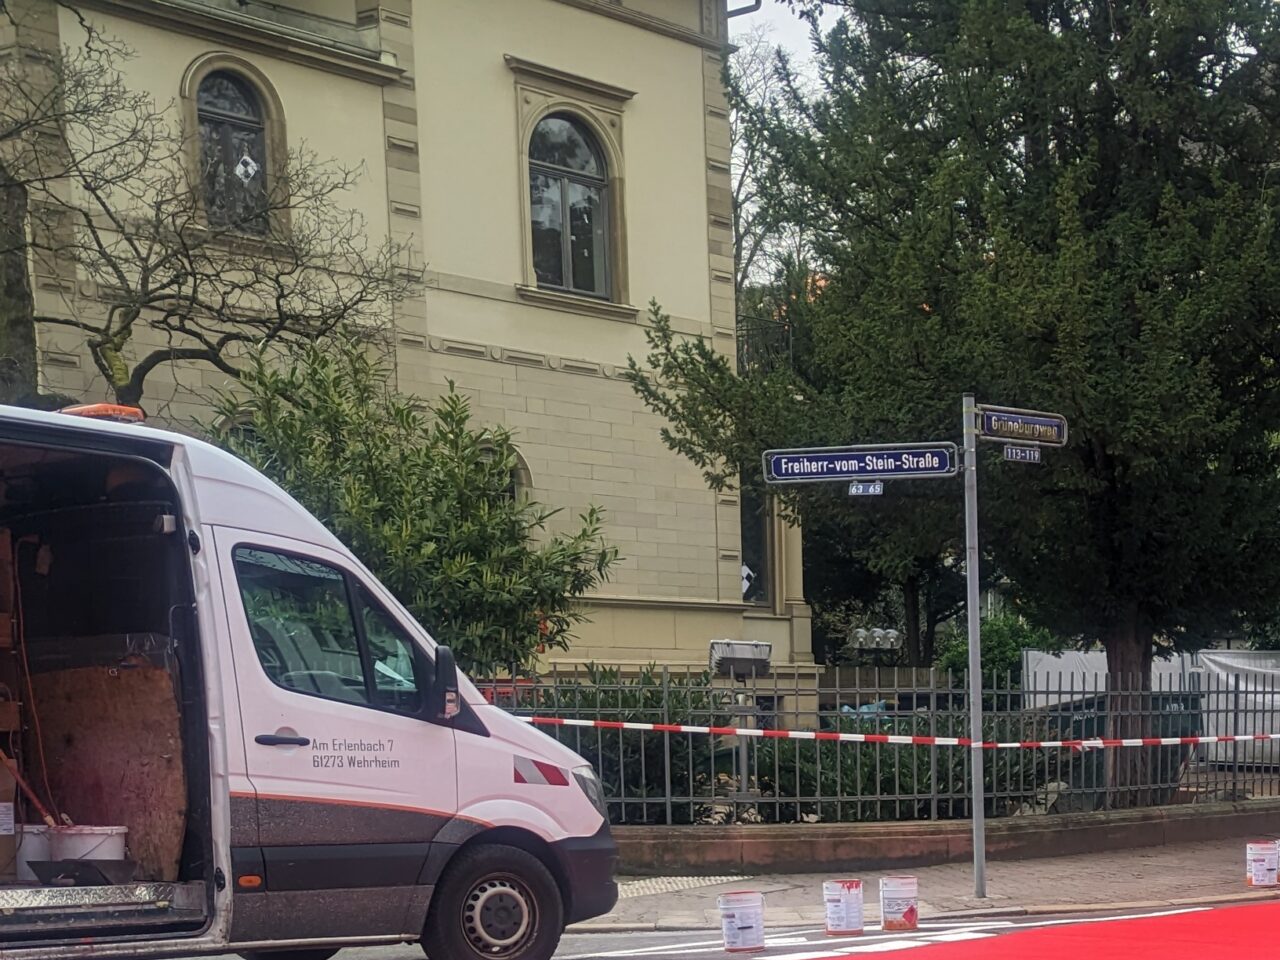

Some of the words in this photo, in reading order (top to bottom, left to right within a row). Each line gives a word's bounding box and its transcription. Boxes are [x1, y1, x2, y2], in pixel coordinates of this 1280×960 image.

[991, 416, 1058, 440] Grüneburgweg
[1007, 448, 1039, 461] 113-119
[781, 452, 939, 473] Freiherr-vom-Stein-Straße
[851, 485, 863, 494] 63
[869, 484, 881, 493] 65
[311, 738, 329, 752] Am
[332, 739, 384, 752] Erlenbach
[387, 739, 394, 752] 7
[312, 755, 344, 769] 61273
[347, 756, 400, 769] Wehrheim
